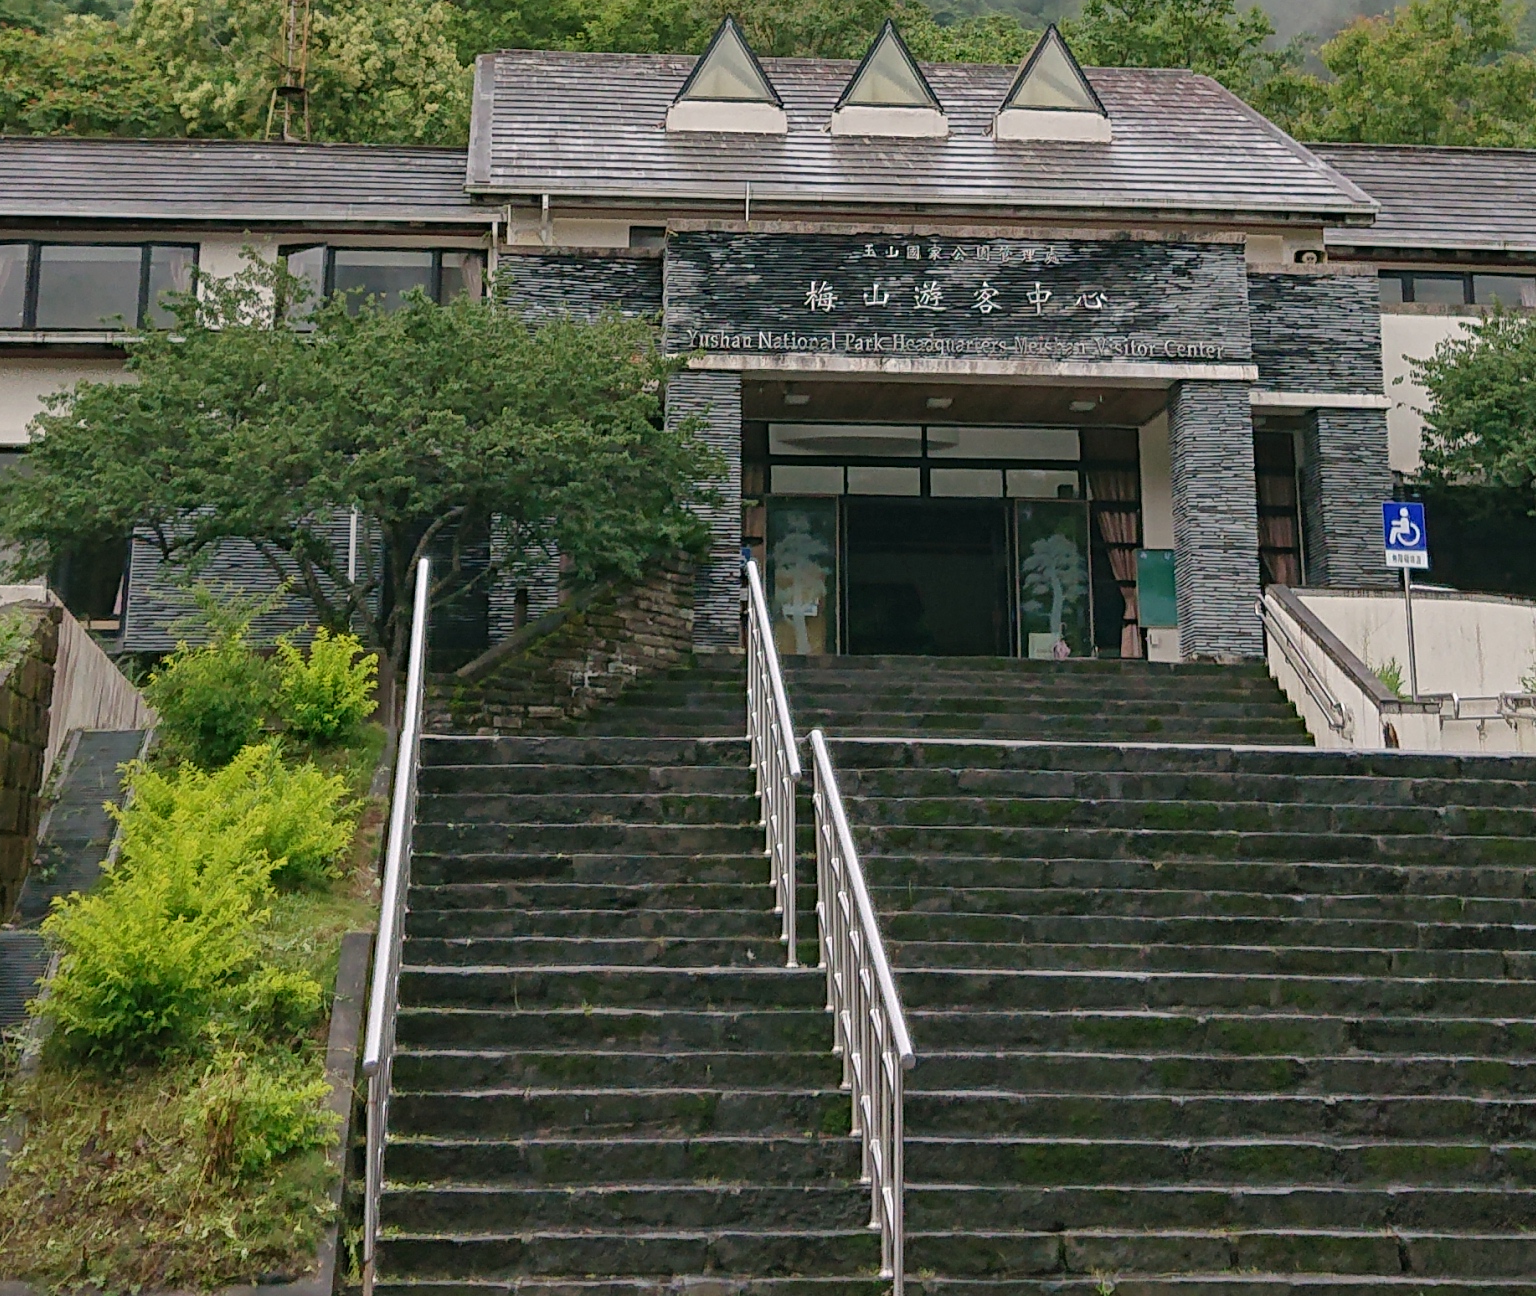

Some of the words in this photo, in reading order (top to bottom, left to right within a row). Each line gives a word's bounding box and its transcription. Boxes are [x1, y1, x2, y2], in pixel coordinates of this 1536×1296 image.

[863, 244, 1061, 265] 玉山國家公園管理處
[804, 280, 1108, 315] 梅山遊客中心
[687, 329, 752, 349] Yushan
[758, 331, 837, 351] National
[844, 333, 885, 352] Park
[892, 333, 1007, 357] Headquarters
[1014, 336, 1087, 355] Meishan
[1093, 337, 1156, 357] Visitor
[1164, 339, 1225, 359] Center
